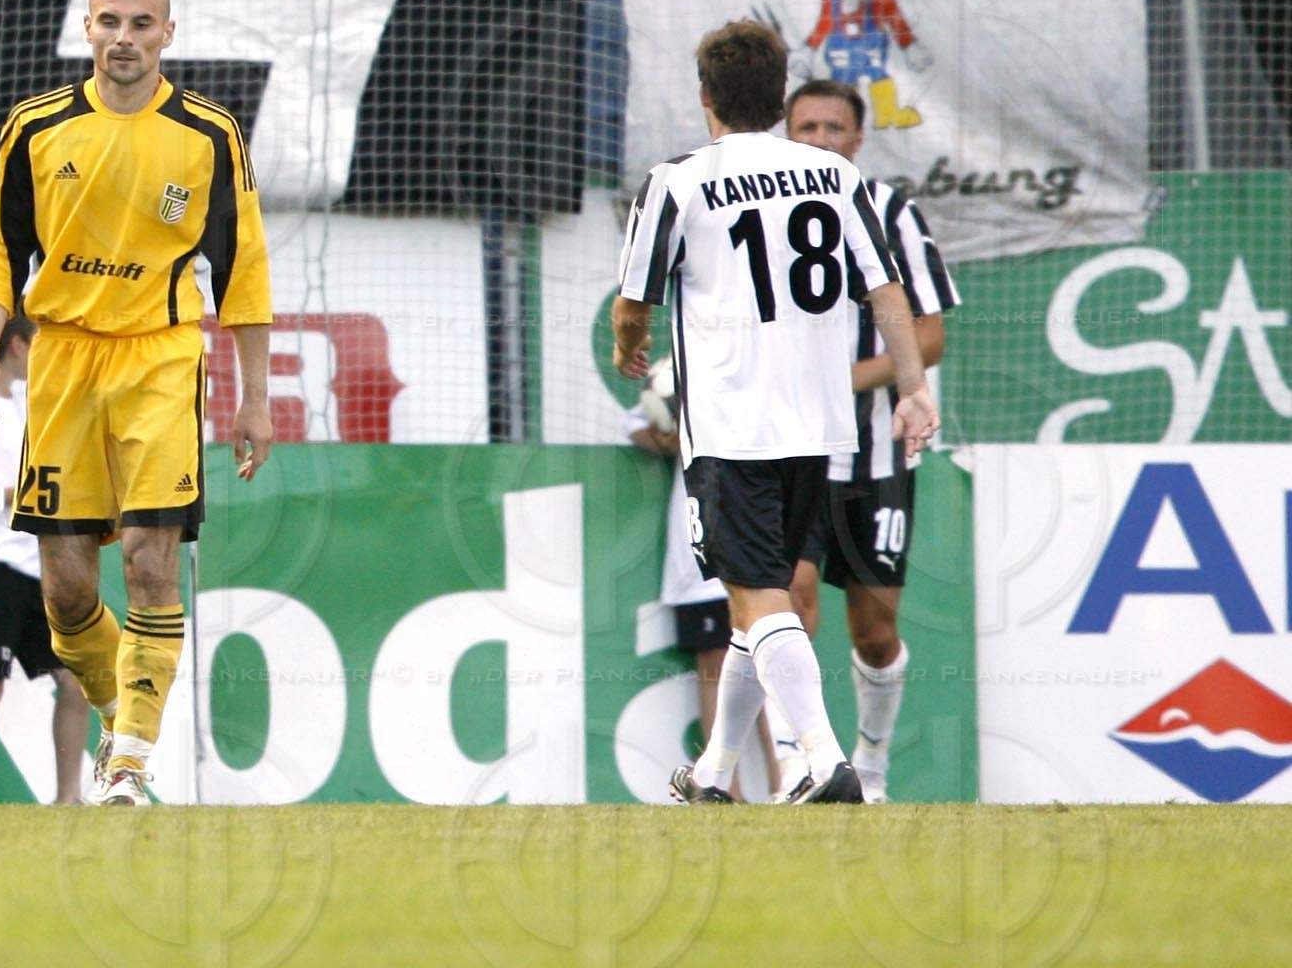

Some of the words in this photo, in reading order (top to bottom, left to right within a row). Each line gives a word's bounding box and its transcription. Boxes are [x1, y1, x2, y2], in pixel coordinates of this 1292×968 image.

[701, 167, 841, 211] KANDELAKI
[728, 200, 843, 324] 18
[16, 465, 62, 517] 25
[873, 507, 907, 554] 10
[1067, 462, 1292, 635] A
